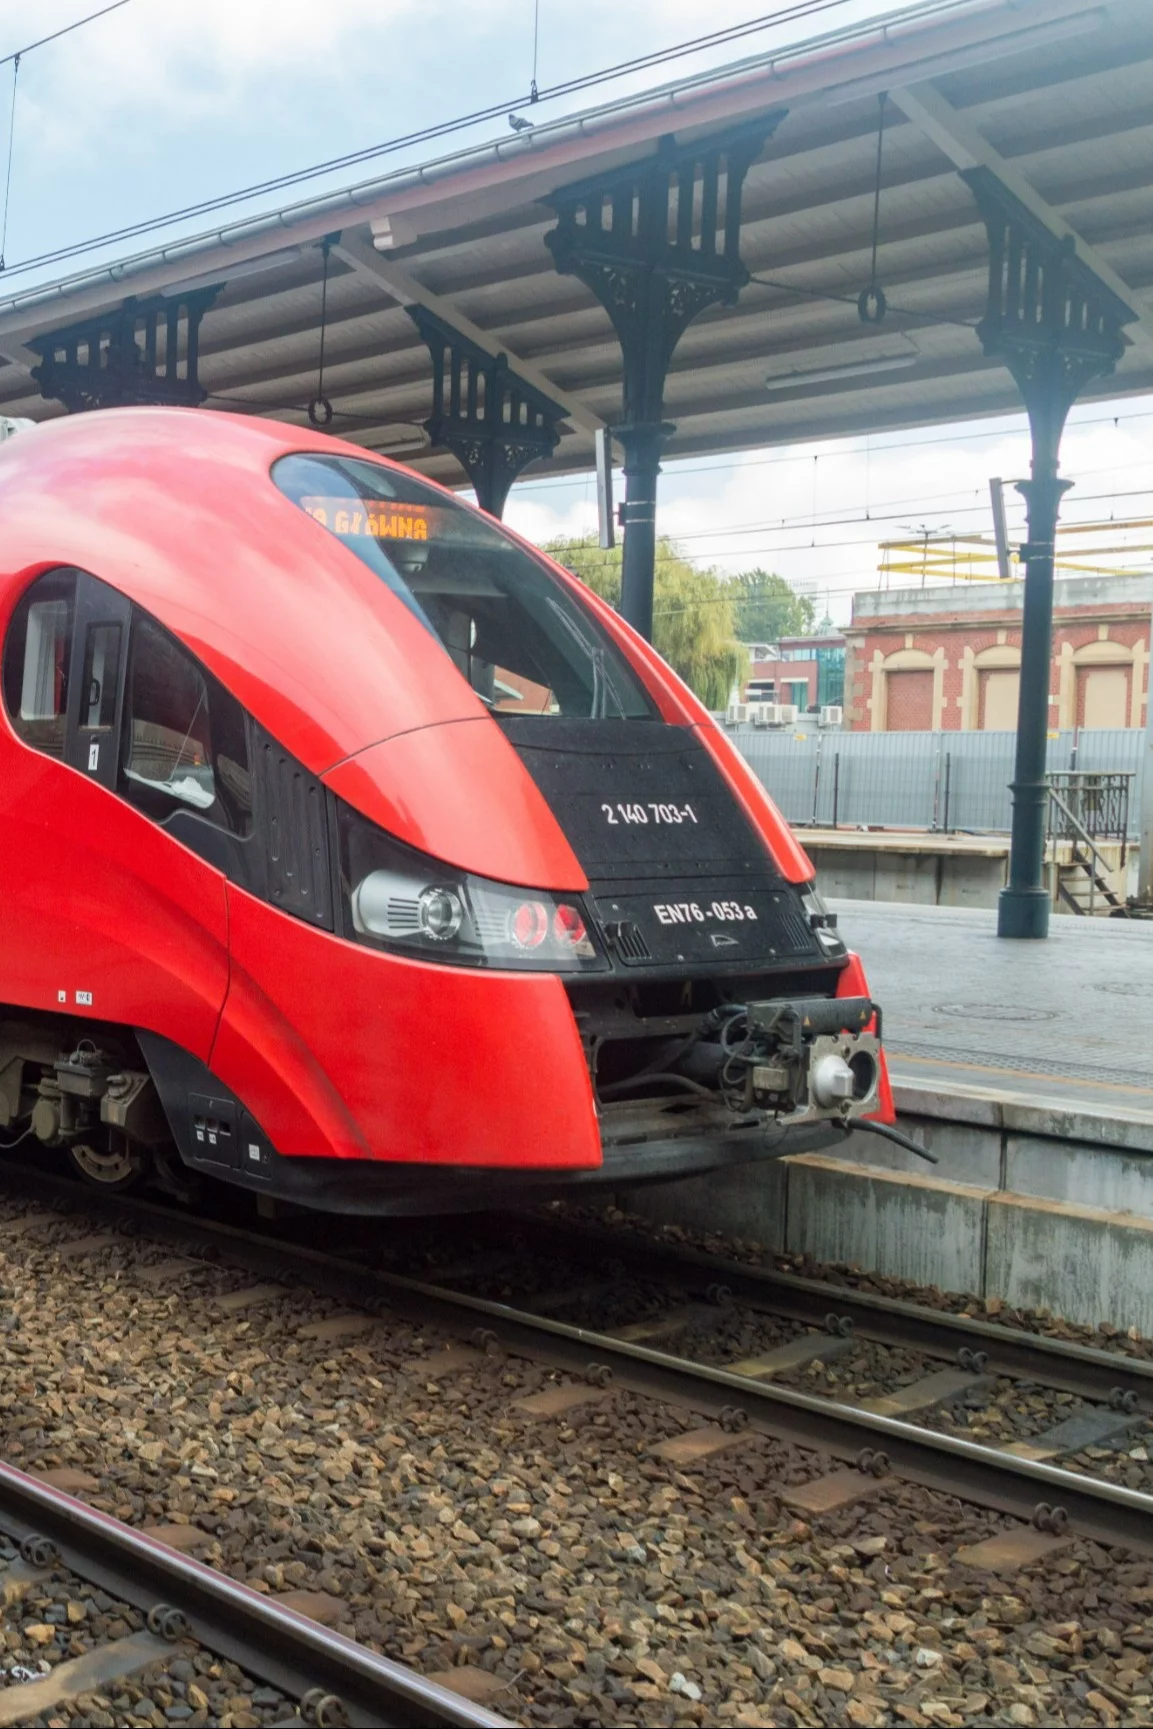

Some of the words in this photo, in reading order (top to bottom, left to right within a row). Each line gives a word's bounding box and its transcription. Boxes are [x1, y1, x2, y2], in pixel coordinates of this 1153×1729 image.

[601, 803, 619, 825] 2
[617, 803, 648, 824] 140
[648, 803, 698, 824] 703-1
